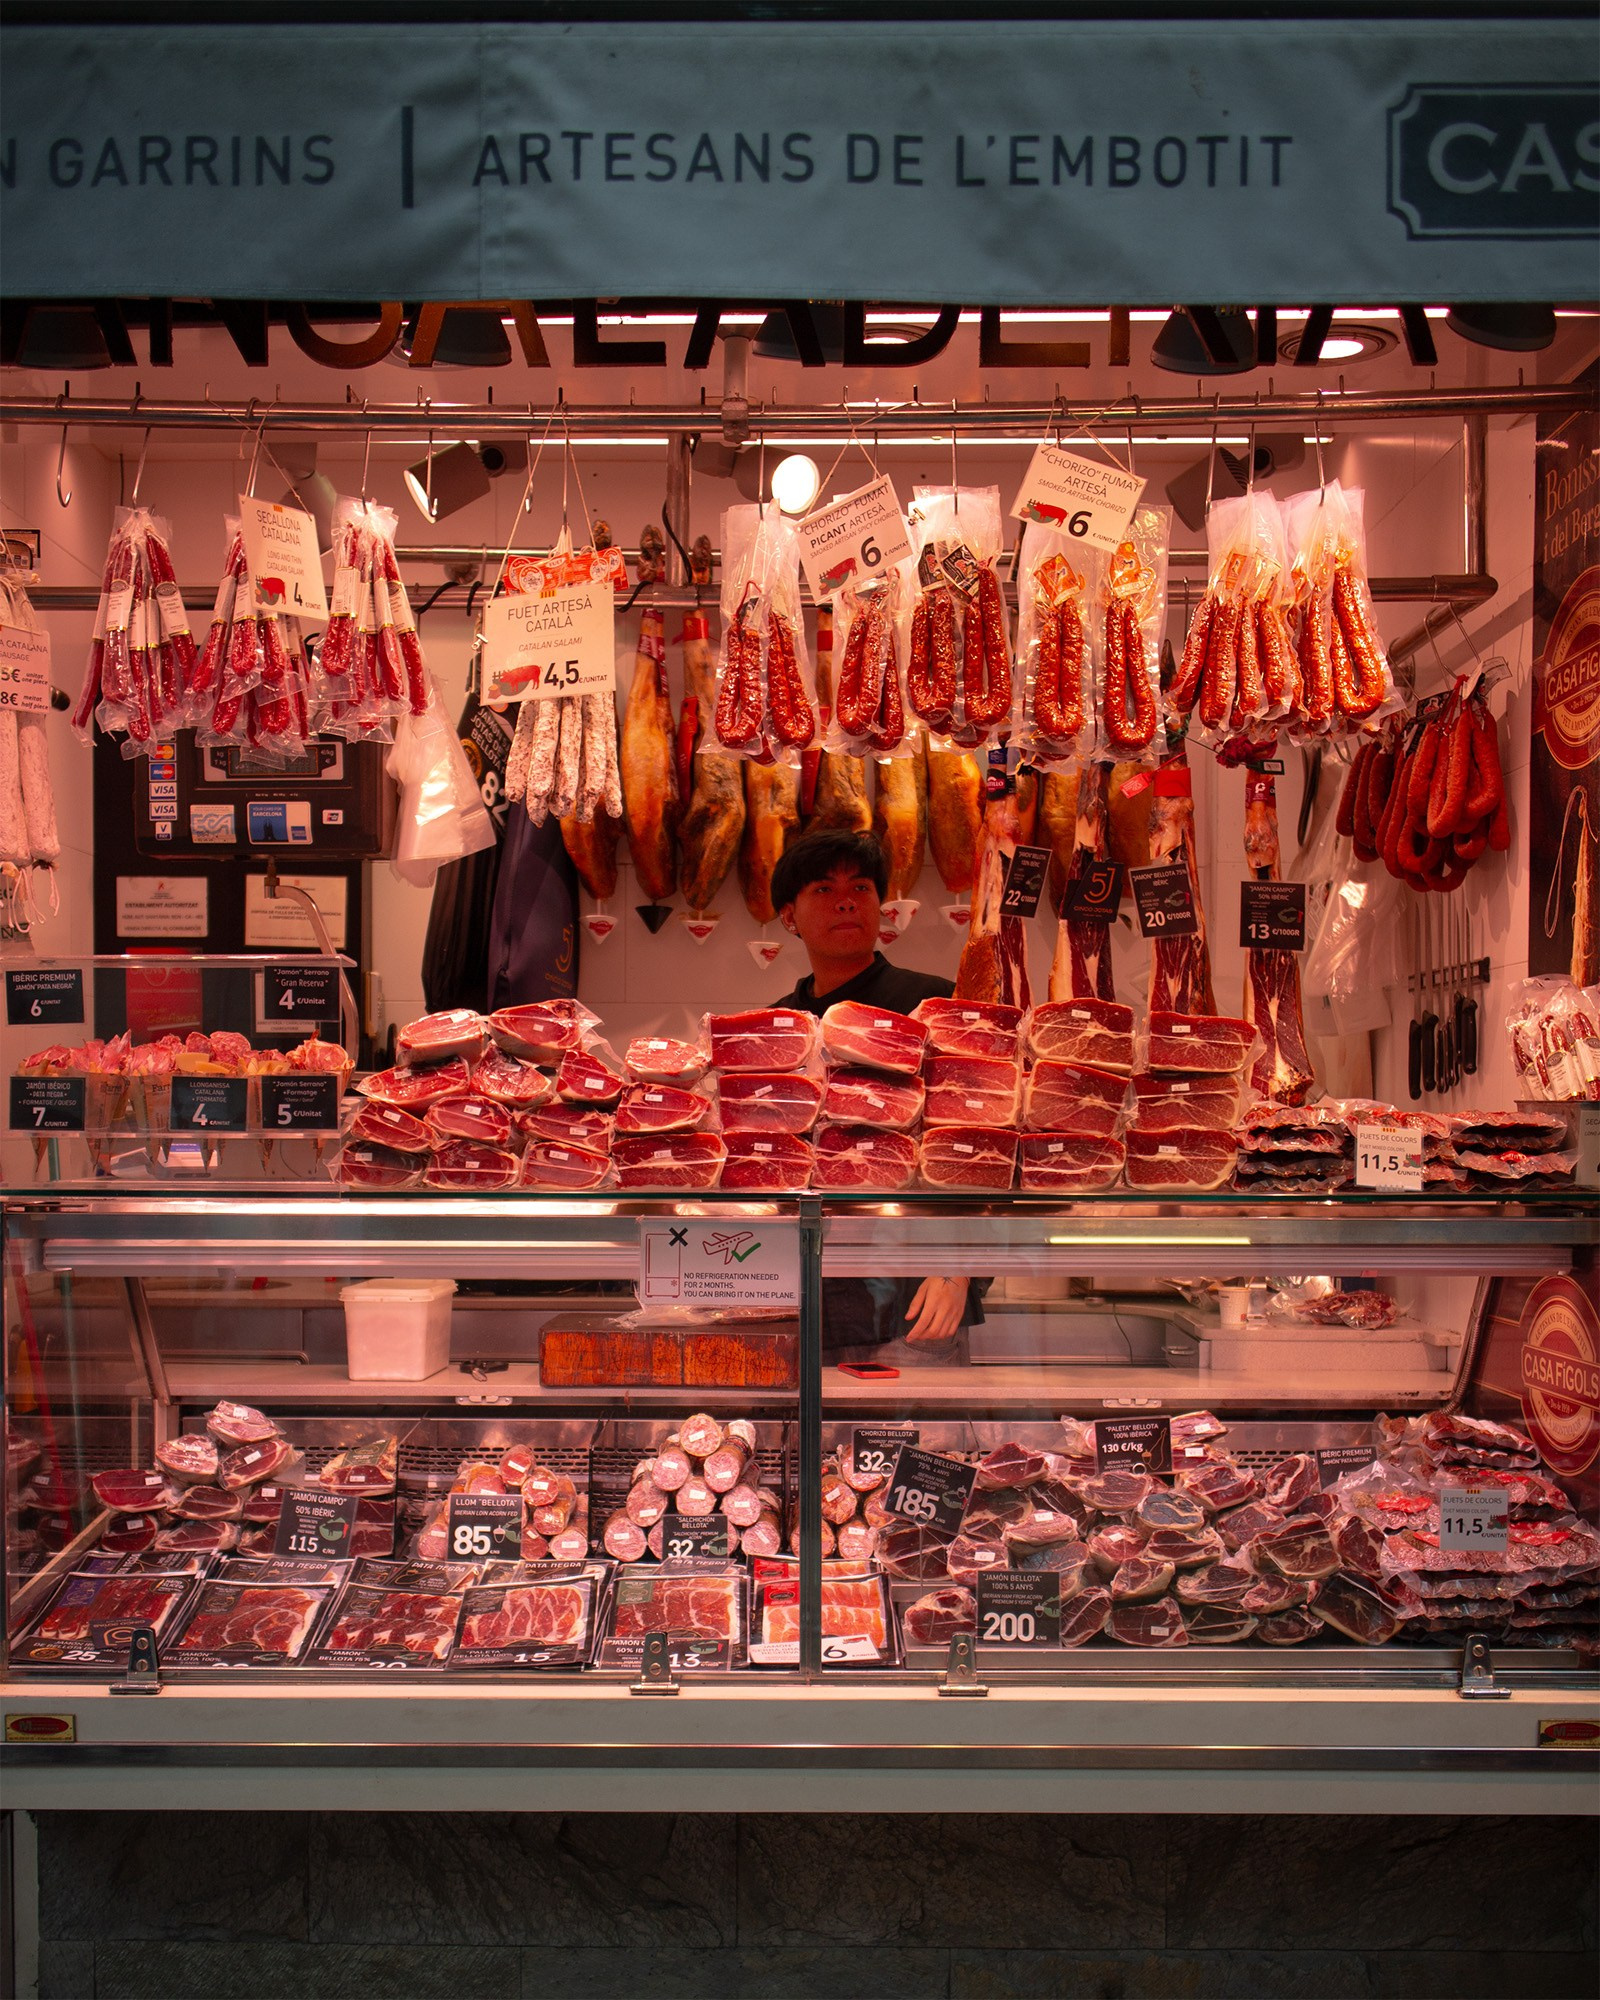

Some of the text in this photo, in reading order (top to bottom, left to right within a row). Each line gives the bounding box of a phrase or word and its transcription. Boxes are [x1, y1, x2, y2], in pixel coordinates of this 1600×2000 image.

[48, 134, 336, 189] GARRINS
[472, 131, 1294, 189] ARTESANS DE L'EMBOTIT
[1037, 478, 1127, 514] SMOKED ARTISAN CHORIZO
[1064, 476, 1107, 497] ARTESÀ
[854, 484, 889, 509] FUMAT
[256, 509, 301, 533] SECALLONA
[810, 503, 886, 548] PICANT ARTESÀ
[1068, 511, 1092, 537] 6
[262, 526, 300, 546] CATALANA
[810, 508, 899, 559] SMOKED ARTISAN SPICY CHORIZO
[1551, 516, 1569, 558] del
[267, 551, 292, 562] LONG AND
[861, 536, 881, 567] 6
[294, 582, 303, 606] 4
[508, 595, 592, 620] FUET ARTESÀ
[526, 612, 573, 633] CATALÀ
[6, 639, 48, 654] CATALANA
[519, 637, 582, 652] CATALAN SALAMI
[544, 660, 608, 690] 4,5 €/UNITAT
[1548, 668, 1580, 701] CASA
[471, 714, 493, 743] JOTAS
[154, 786, 174, 794] VISA
[154, 806, 175, 814] VISA
[1005, 890, 1021, 906] 22
[1145, 911, 1165, 928] 20
[1248, 923, 1270, 939] 13
[12, 973, 38, 982] IBÈRIC
[281, 979, 324, 987] Gran Reserva
[31, 999, 42, 1017] 6
[279, 989, 295, 1010] 4
[26, 1081, 70, 1089] JAMÓN IBÉRICO
[32, 1107, 46, 1126] 7
[192, 1103, 208, 1126] 4
[277, 1104, 292, 1125] 5
[1361, 1153, 1399, 1172] 11,5
[1523, 1352, 1553, 1385] CASA
[1102, 1442, 1143, 1453] 130 €/kg
[1320, 1448, 1372, 1458] IBÈRIC PREMIUM
[859, 1451, 885, 1472] 32
[918, 1462, 931, 1471] 75%
[934, 1457, 964, 1472] BELLOTA"
[290, 1492, 347, 1505] "JAMÓN CAMPO"
[480, 1499, 517, 1507] "BELLOTA"
[894, 1485, 940, 1520] 185
[295, 1506, 311, 1515] 50%
[1444, 1518, 1483, 1536] 11,5
[288, 1535, 319, 1553] 115
[453, 1525, 491, 1555] 85
[668, 1539, 694, 1558] 32
[297, 1562, 327, 1570] NEGRA
[436, 1564, 466, 1572] NEGRA
[983, 1612, 1035, 1642] 200
[60, 1650, 100, 1662] 25
[514, 1652, 551, 1662] 15
[669, 1653, 700, 1667] 13
[823, 1645, 847, 1658] 6
